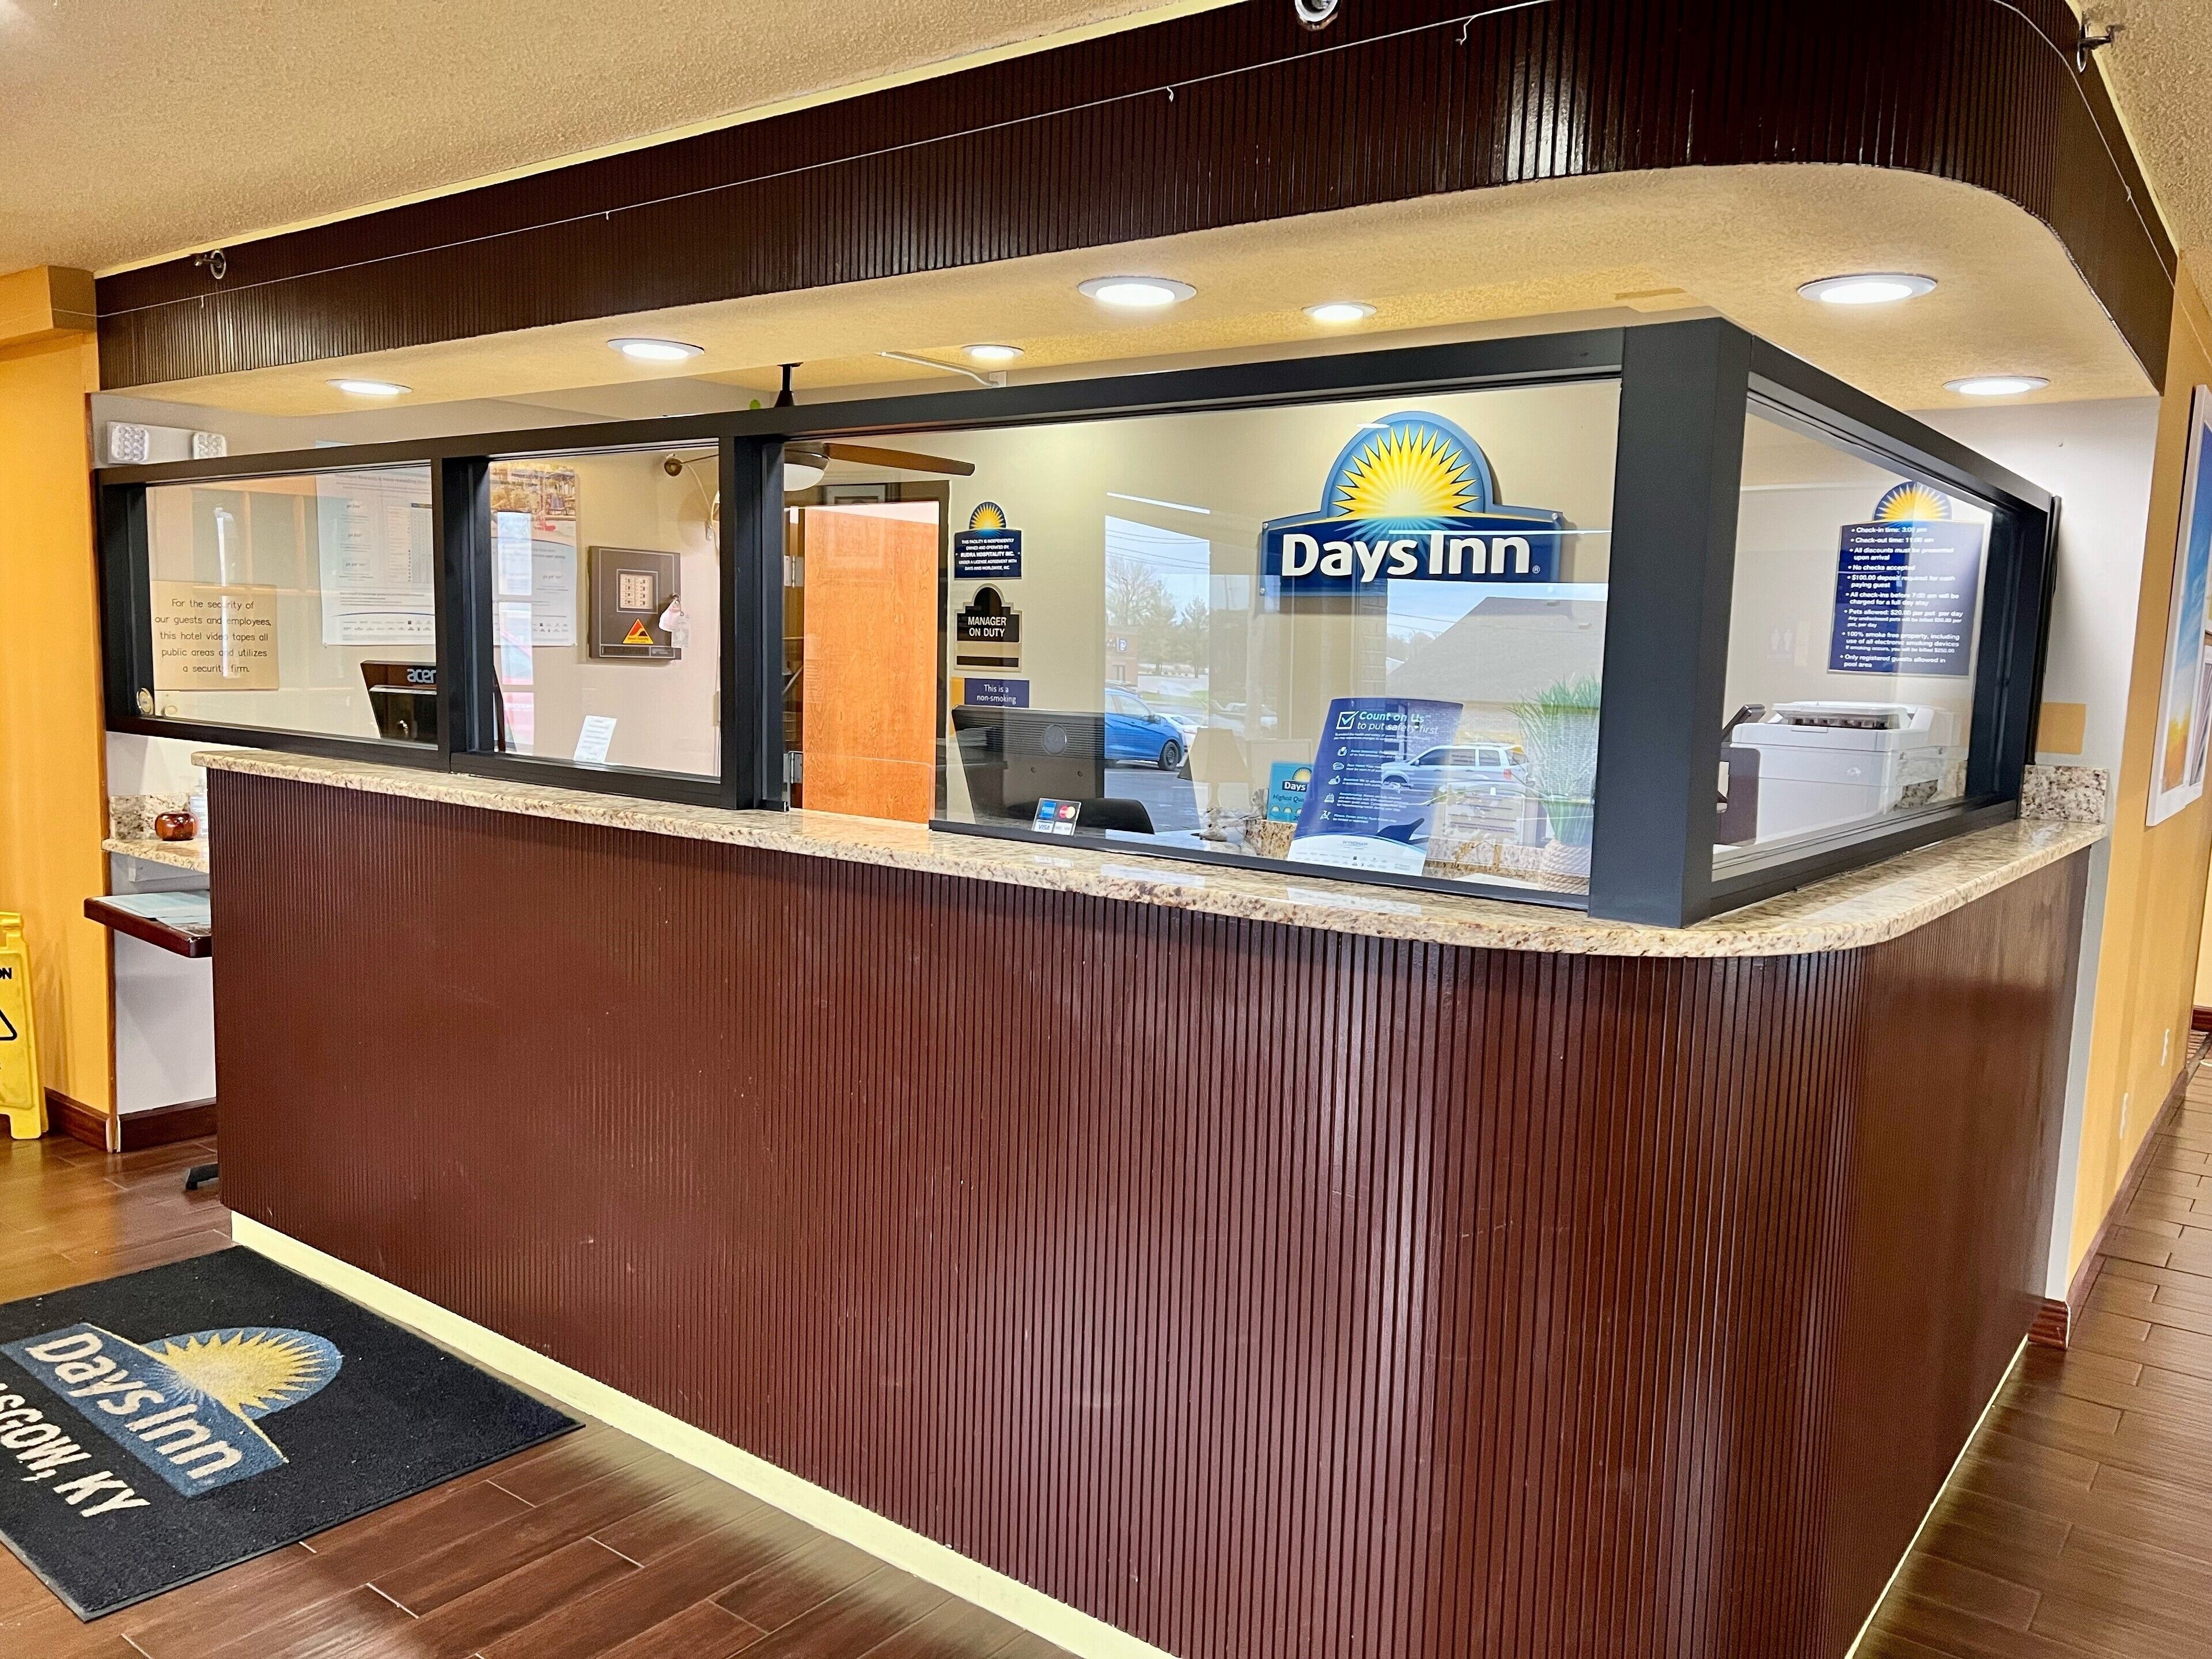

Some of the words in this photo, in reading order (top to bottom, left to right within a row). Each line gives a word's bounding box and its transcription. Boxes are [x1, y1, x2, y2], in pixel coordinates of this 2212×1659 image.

[1282, 533, 1418, 582] Days
[1429, 533, 1530, 574] Inn
[172, 598, 185, 608] For
[174, 616, 202, 625] guests
[207, 616, 222, 624] and
[227, 618, 271, 626] employees,
[968, 616, 1007, 626] MANAGER
[160, 631, 176, 639] this
[181, 632, 202, 640] hotel
[233, 634, 255, 642] tapes
[969, 628, 980, 637] ON
[984, 628, 1005, 637] DUTY
[162, 648, 187, 658] public
[238, 649, 267, 657] utilizes
[407, 668, 436, 683] acer
[977, 695, 1016, 704] non-smoking
[1359, 711, 1391, 720] Count
[1411, 714, 1425, 723] Us
[1357, 722, 1366, 730] to
[1368, 722, 1385, 731] put
[1385, 724, 1415, 733] safety
[1419, 726, 1438, 734] first
[1284, 782, 1306, 791] Days
[25, 1332, 166, 1415] Days
[125, 1403, 243, 1479] Inn
[52, 1470, 150, 1517] KY
